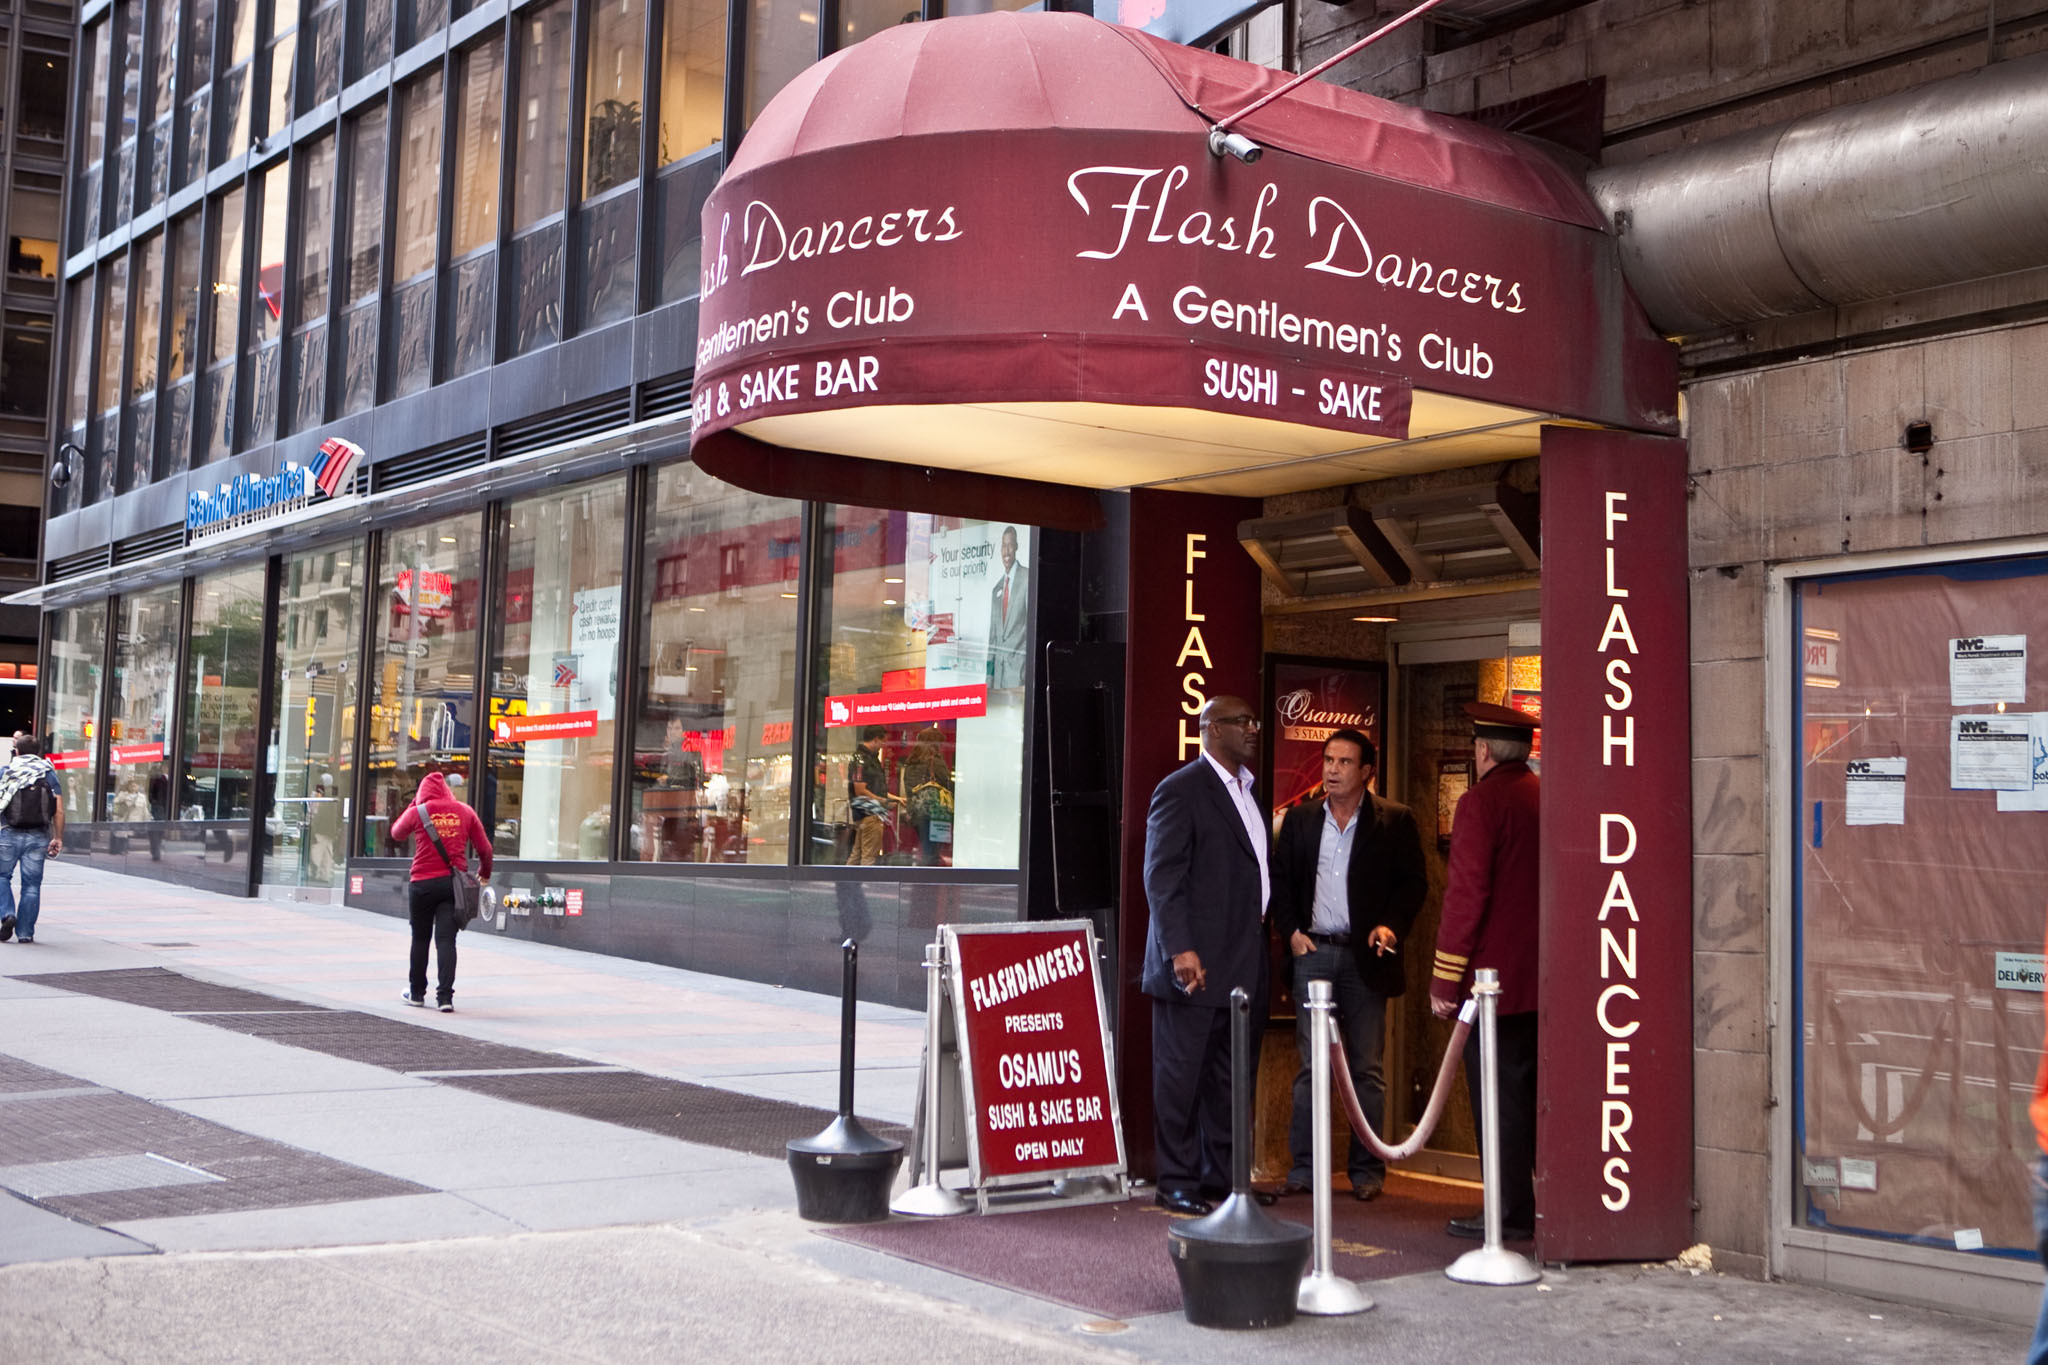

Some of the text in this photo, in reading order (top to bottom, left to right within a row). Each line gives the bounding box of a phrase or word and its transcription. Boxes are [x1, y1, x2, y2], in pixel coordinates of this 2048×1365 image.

[741, 200, 963, 277] Dancers
[1067, 165, 1527, 313] Flash Dancers
[696, 287, 914, 370] Gentlemen's Club
[1112, 283, 1494, 379] A Gentlemen's Club
[717, 381, 730, 416] &
[739, 364, 799, 410] SAKE
[815, 355, 879, 396] BAR
[1204, 358, 1278, 406] SUSHI
[1319, 378, 1382, 422] SAKE
[187, 460, 305, 530] Bank of America
[941, 539, 996, 563] Your security
[942, 565, 948, 578] is
[963, 560, 988, 578] priority
[579, 596, 613, 614] Credit card
[588, 630, 596, 641] no
[597, 627, 616, 641] hoops
[1176, 533, 1213, 761] FLASH
[1597, 491, 1640, 767] FLASH
[1957, 639, 1984, 651] NYC
[1276, 689, 1375, 728] Osamu's
[1960, 721, 1988, 733] NYC
[1294, 728, 1299, 738] 5
[1302, 729, 1325, 740] STAR
[970, 940, 1085, 1012] FLASHDANCERS
[1005, 1012, 1064, 1033] PRESENTS
[1597, 813, 1640, 1212] DANCERS
[999, 1049, 1082, 1089] OSAMU'S
[988, 1096, 1102, 1131] SUSHI & SAKE BAR
[1015, 1138, 1084, 1161] OPEN DAILY
